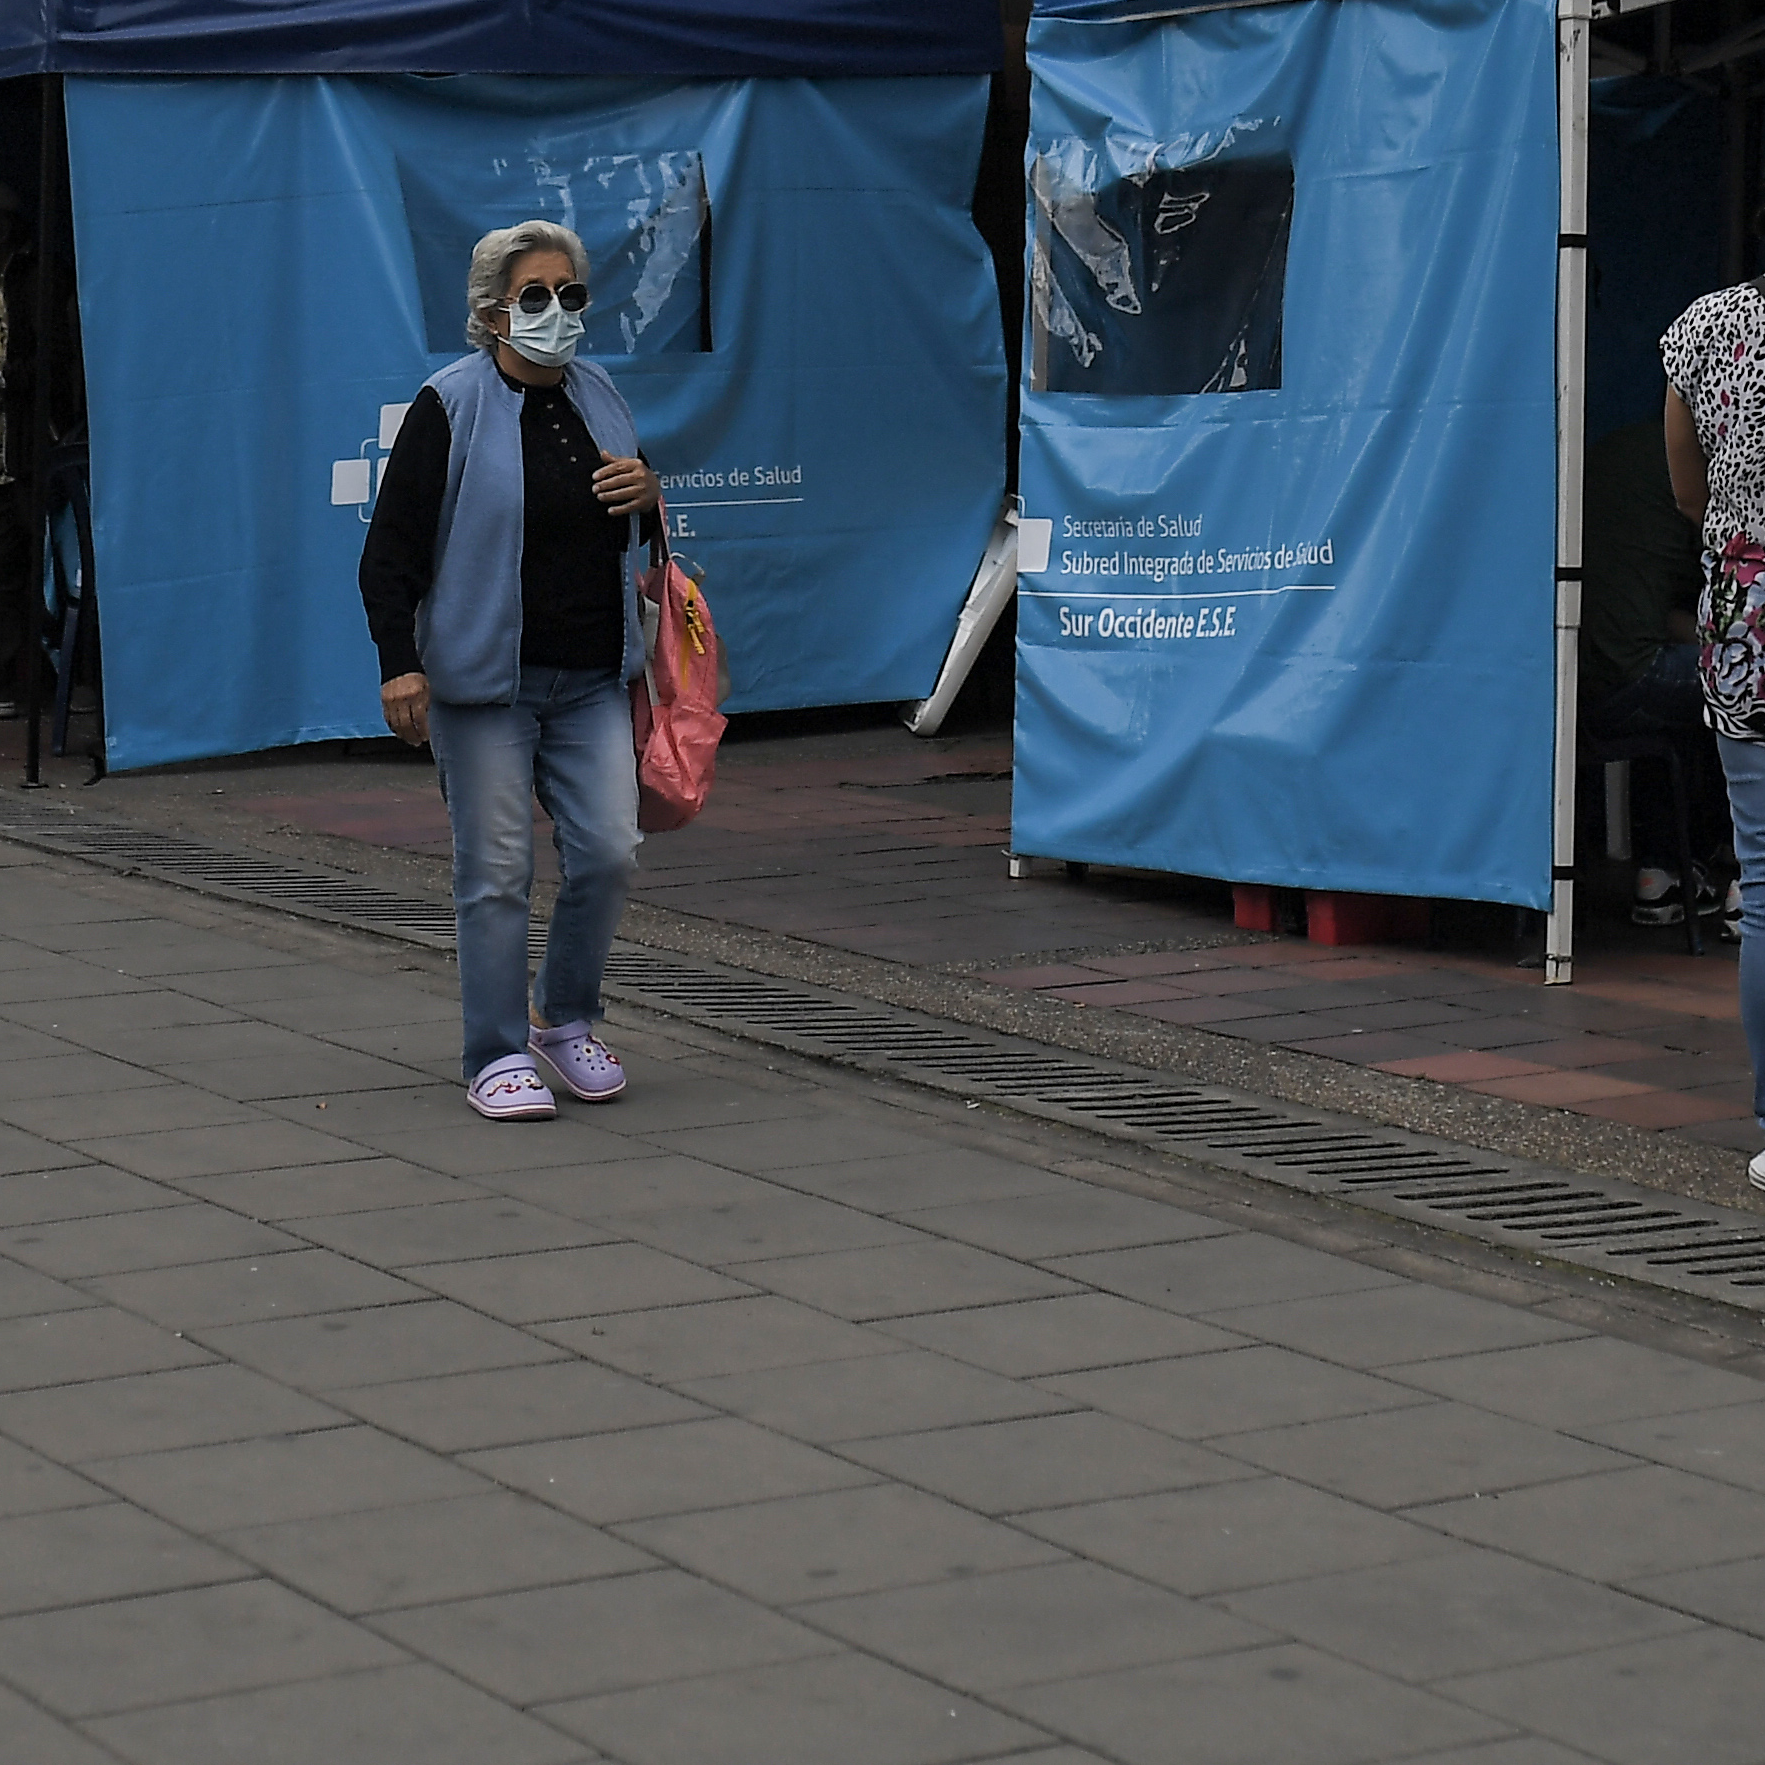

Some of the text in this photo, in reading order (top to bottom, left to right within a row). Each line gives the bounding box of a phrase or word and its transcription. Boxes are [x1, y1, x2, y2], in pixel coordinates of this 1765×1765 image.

[654, 464, 802, 490] ervicios de Salud
[1137, 515, 1155, 538] de
[1157, 513, 1203, 538] Salud
[1060, 550, 1120, 575] Subred
[1123, 550, 1194, 583] Integrada
[1196, 548, 1214, 574] de
[1216, 545, 1273, 574] Servicios
[1274, 543, 1294, 569] de
[1059, 606, 1094, 637] Sur
[1097, 607, 1195, 639] Occidente
